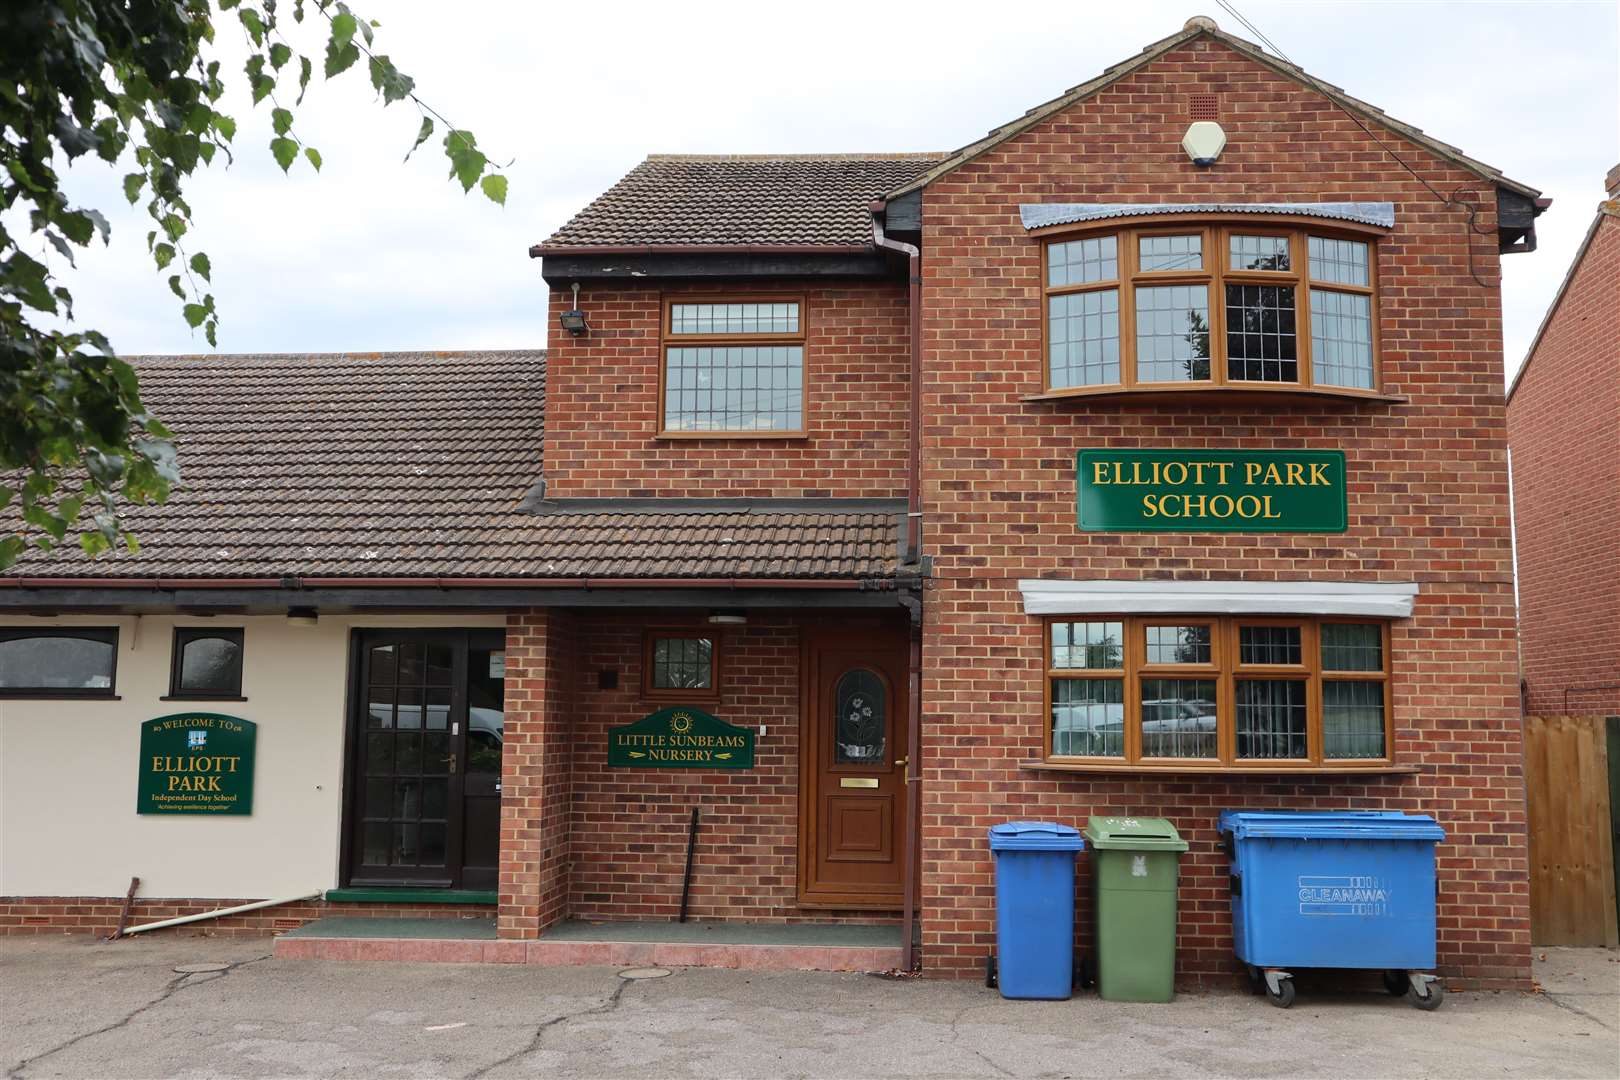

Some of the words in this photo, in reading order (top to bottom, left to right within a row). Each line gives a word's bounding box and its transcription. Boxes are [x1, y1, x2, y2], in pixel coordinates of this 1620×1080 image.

[1092, 462, 1233, 485] ELLIOTT
[1244, 463, 1332, 486] PARK
[1143, 494, 1281, 518] SCHOOL
[163, 719, 215, 730] WELCOME
[219, 720, 234, 730] TO
[617, 734, 666, 747] LITTLE
[669, 735, 745, 748] SUNBEAMS
[648, 749, 713, 762] NURSERY
[152, 756, 240, 773] ELLIOTT
[168, 776, 222, 791] PARK
[152, 794, 196, 803] Independent
[198, 794, 212, 803] Day
[213, 794, 237, 802] School
